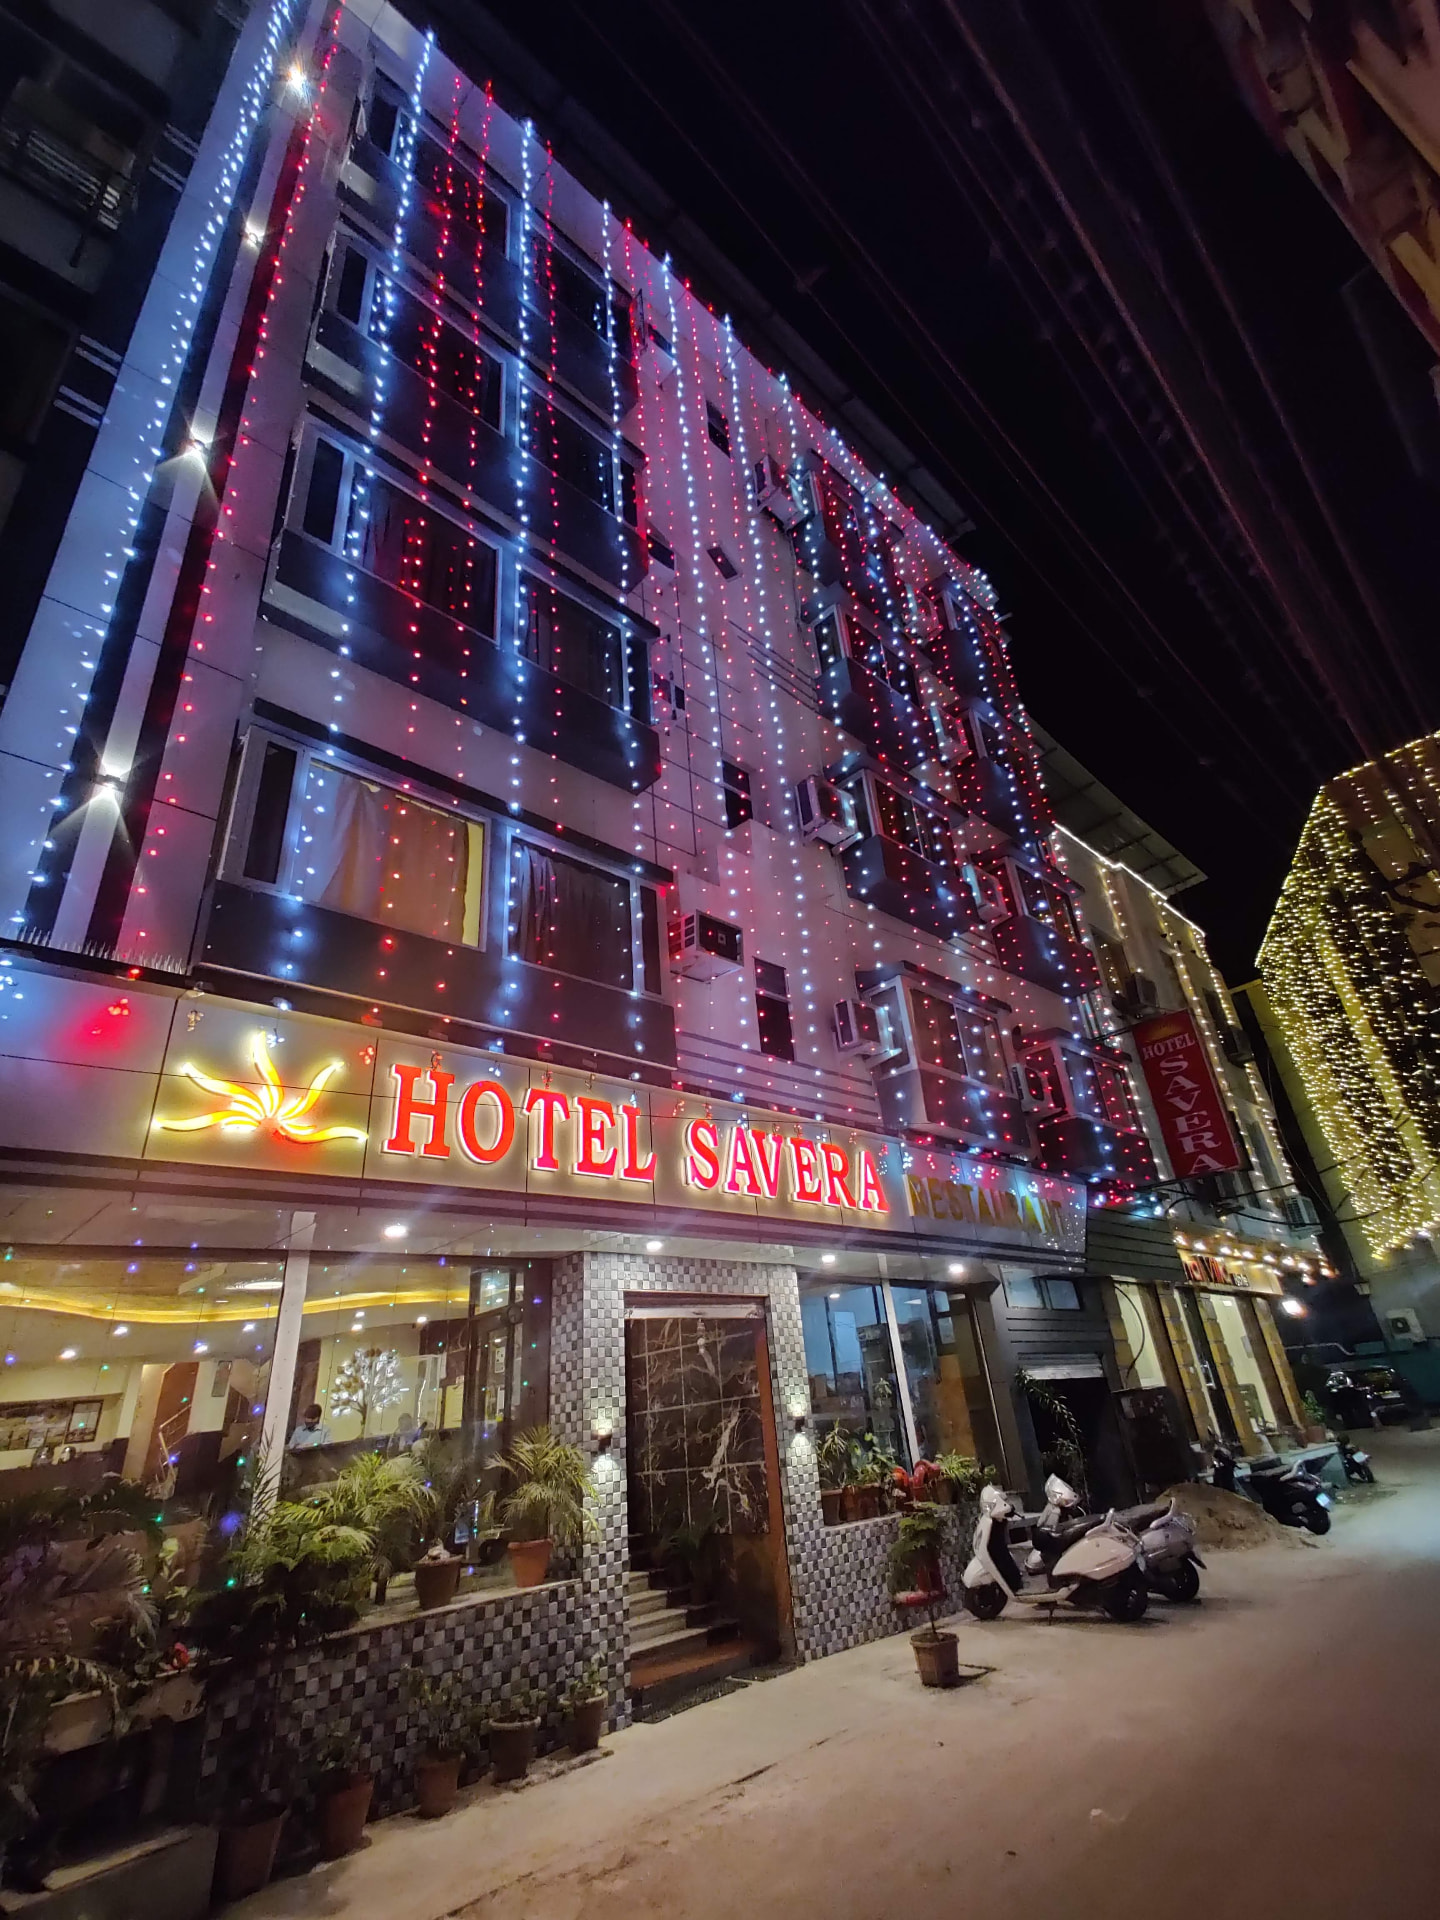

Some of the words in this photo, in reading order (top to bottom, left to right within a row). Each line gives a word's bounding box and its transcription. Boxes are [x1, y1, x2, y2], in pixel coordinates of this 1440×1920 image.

[1143, 1033, 1195, 1060] HOTEL
[383, 1063, 658, 1183] HOTEL
[685, 1118, 890, 1214] SAVERA
[902, 1173, 1066, 1238] RESTAURANT
[1160, 1054, 1226, 1175] SAVERA
